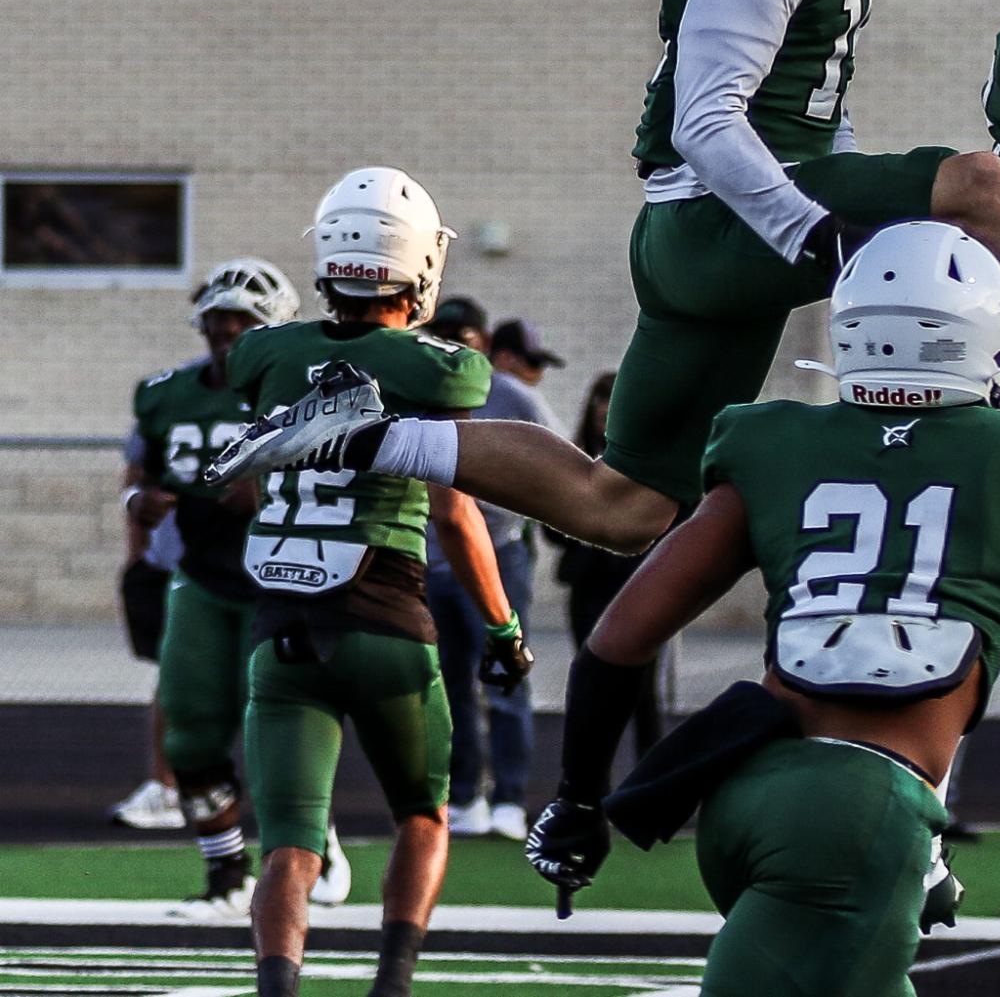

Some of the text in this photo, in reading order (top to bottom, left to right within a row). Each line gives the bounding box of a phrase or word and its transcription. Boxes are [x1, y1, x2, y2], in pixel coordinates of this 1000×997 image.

[327, 262, 389, 281] Riddell
[852, 384, 942, 406] Riddell
[780, 482, 955, 619] 21
[264, 566, 321, 583] BATTLE
